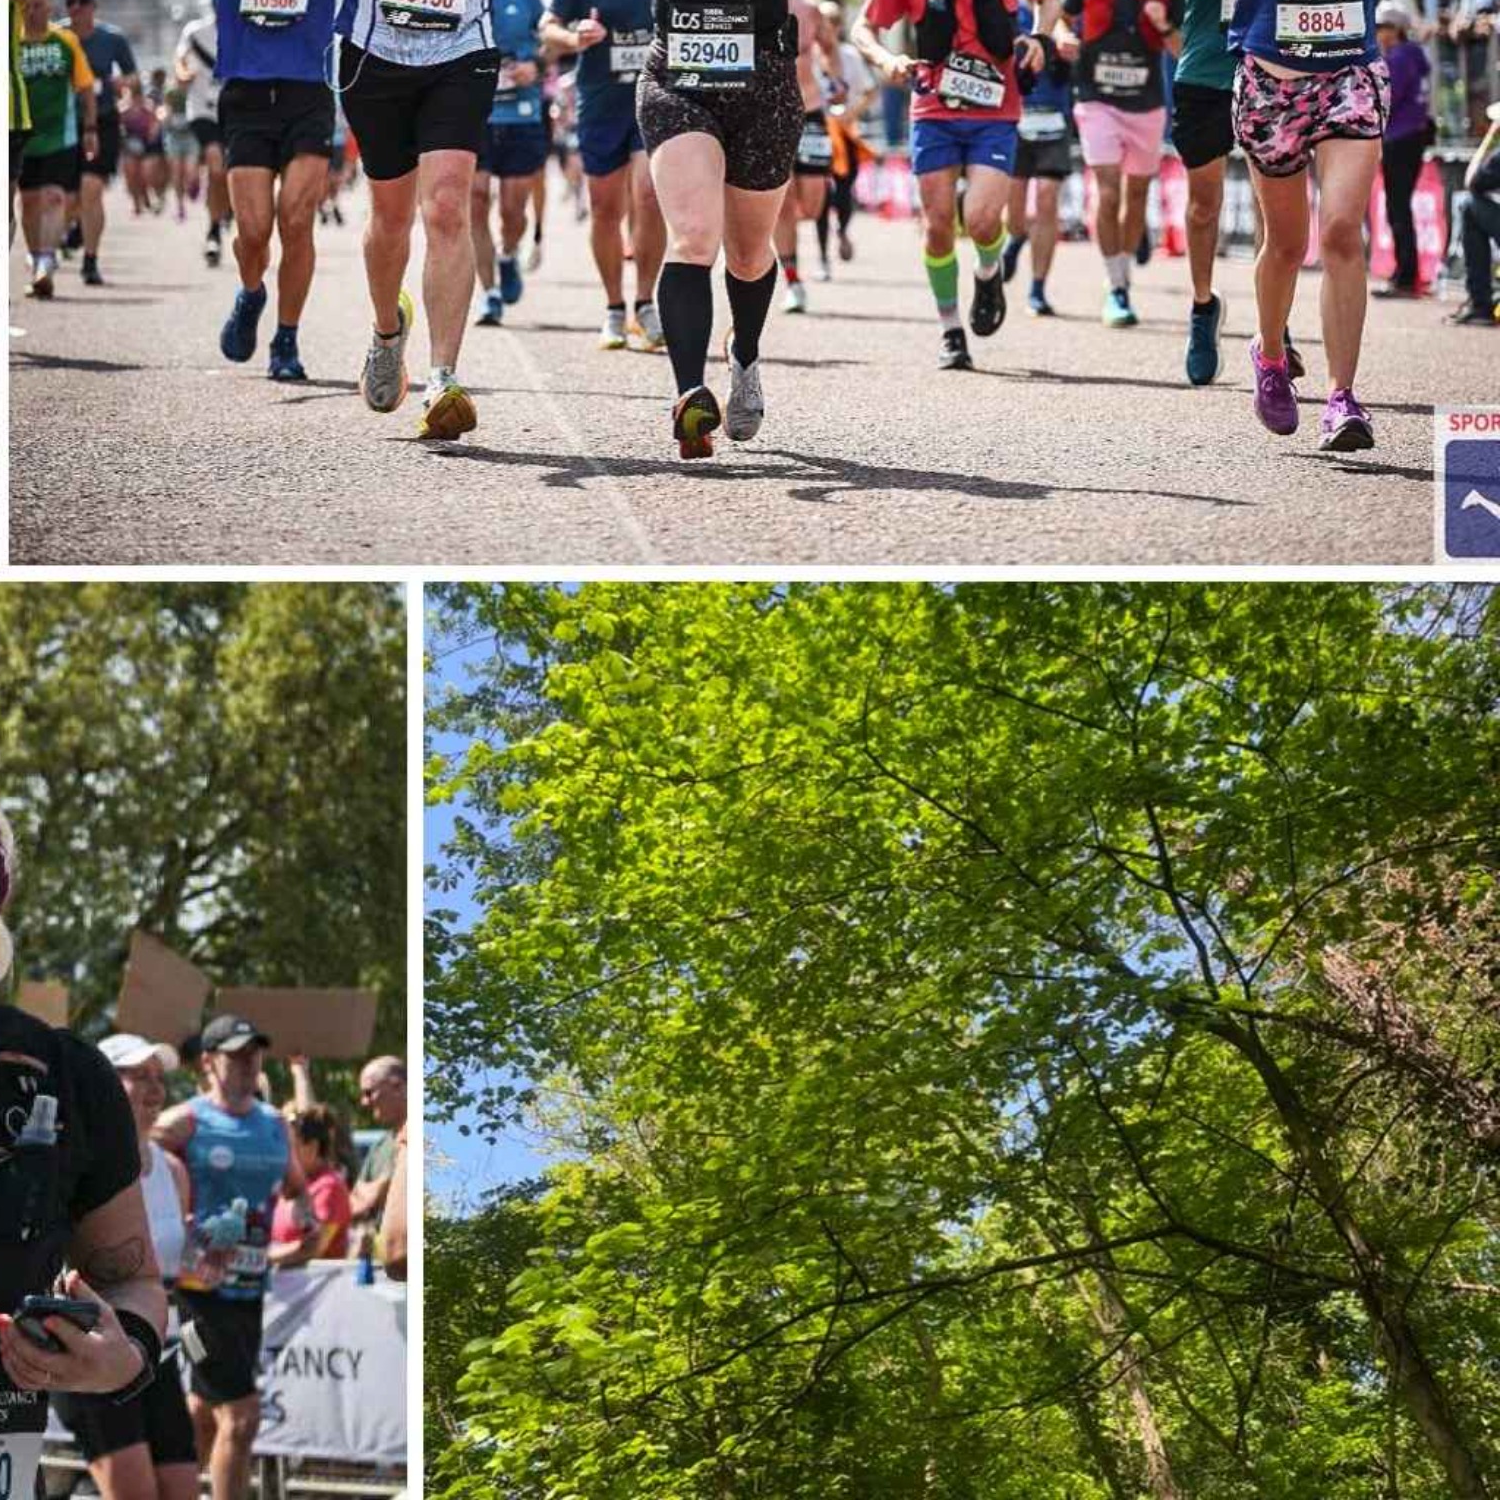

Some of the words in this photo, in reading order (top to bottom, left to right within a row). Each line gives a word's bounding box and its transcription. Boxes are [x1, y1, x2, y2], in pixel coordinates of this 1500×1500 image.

[671, 8, 700, 29] tcs
[1298, 10, 1346, 33] 8884
[680, 42, 739, 63] 52940
